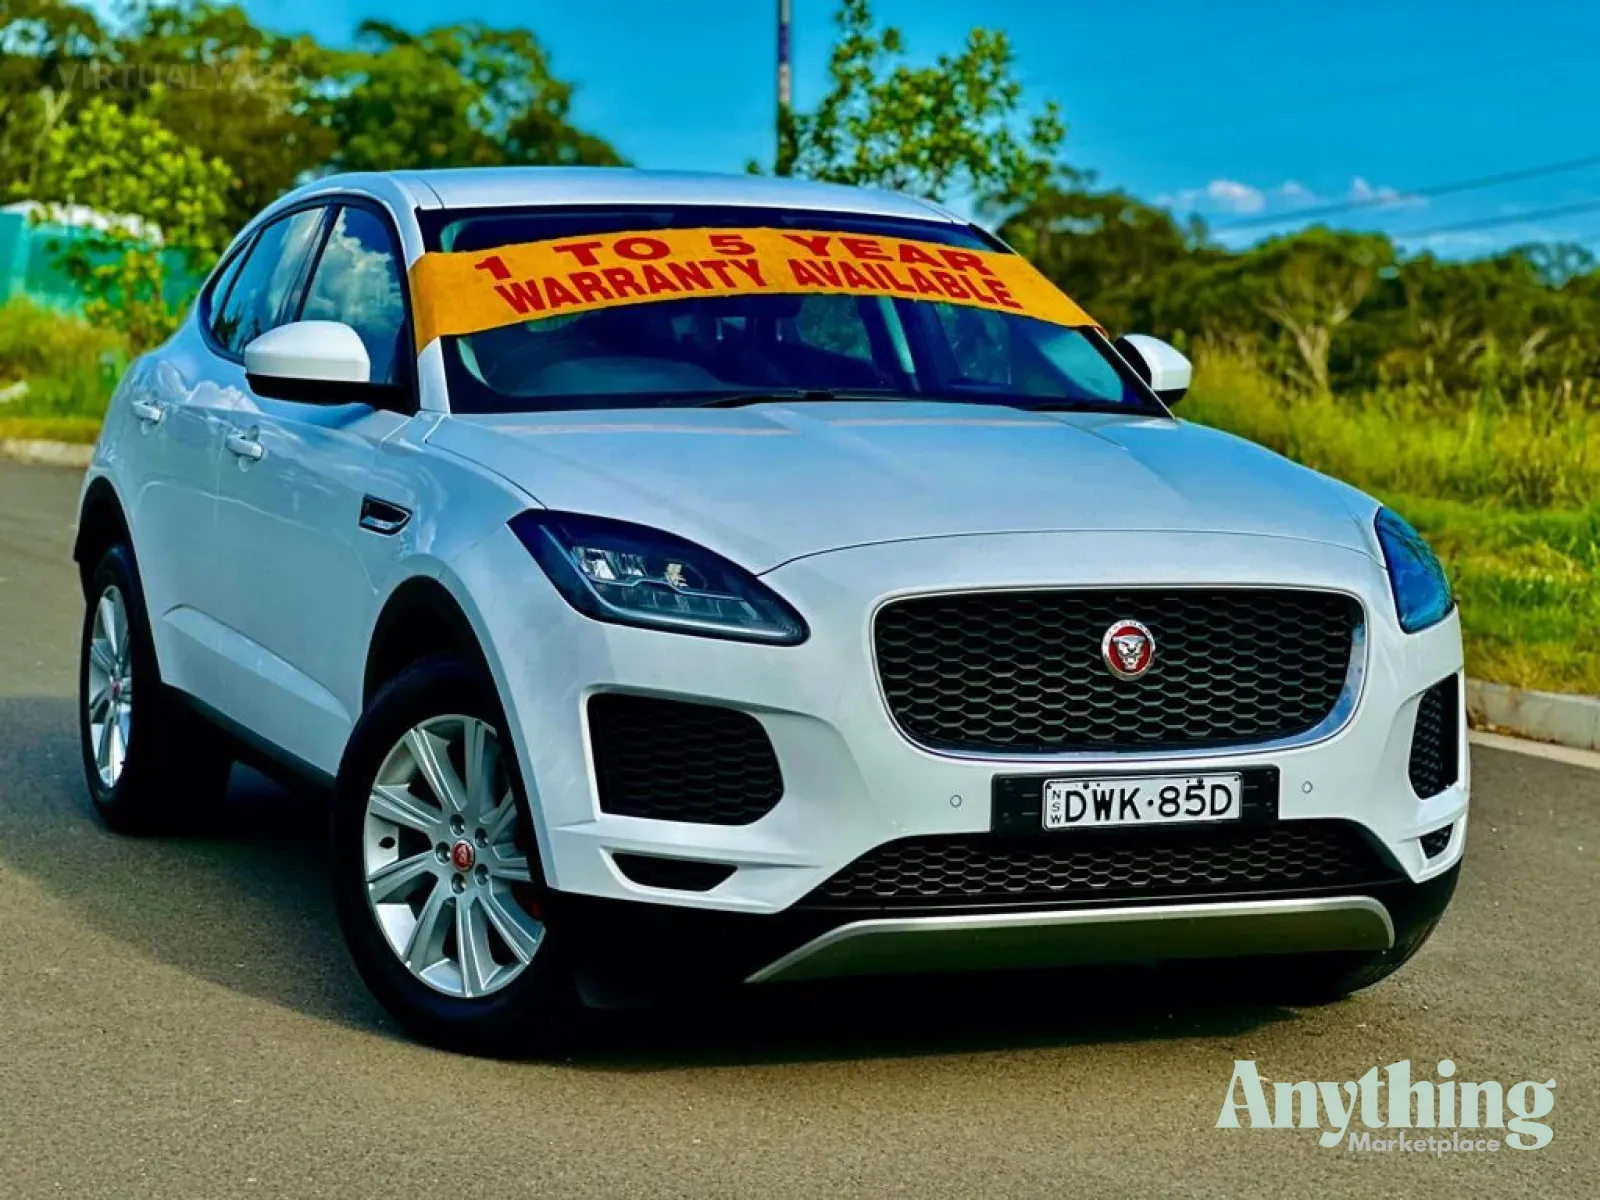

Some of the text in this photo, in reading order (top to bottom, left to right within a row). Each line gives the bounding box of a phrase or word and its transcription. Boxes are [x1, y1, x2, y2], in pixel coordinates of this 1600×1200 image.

[475, 234, 995, 280] 1 TO 5 YEAR
[494, 259, 1023, 314] WARRANTY AVAILABLE
